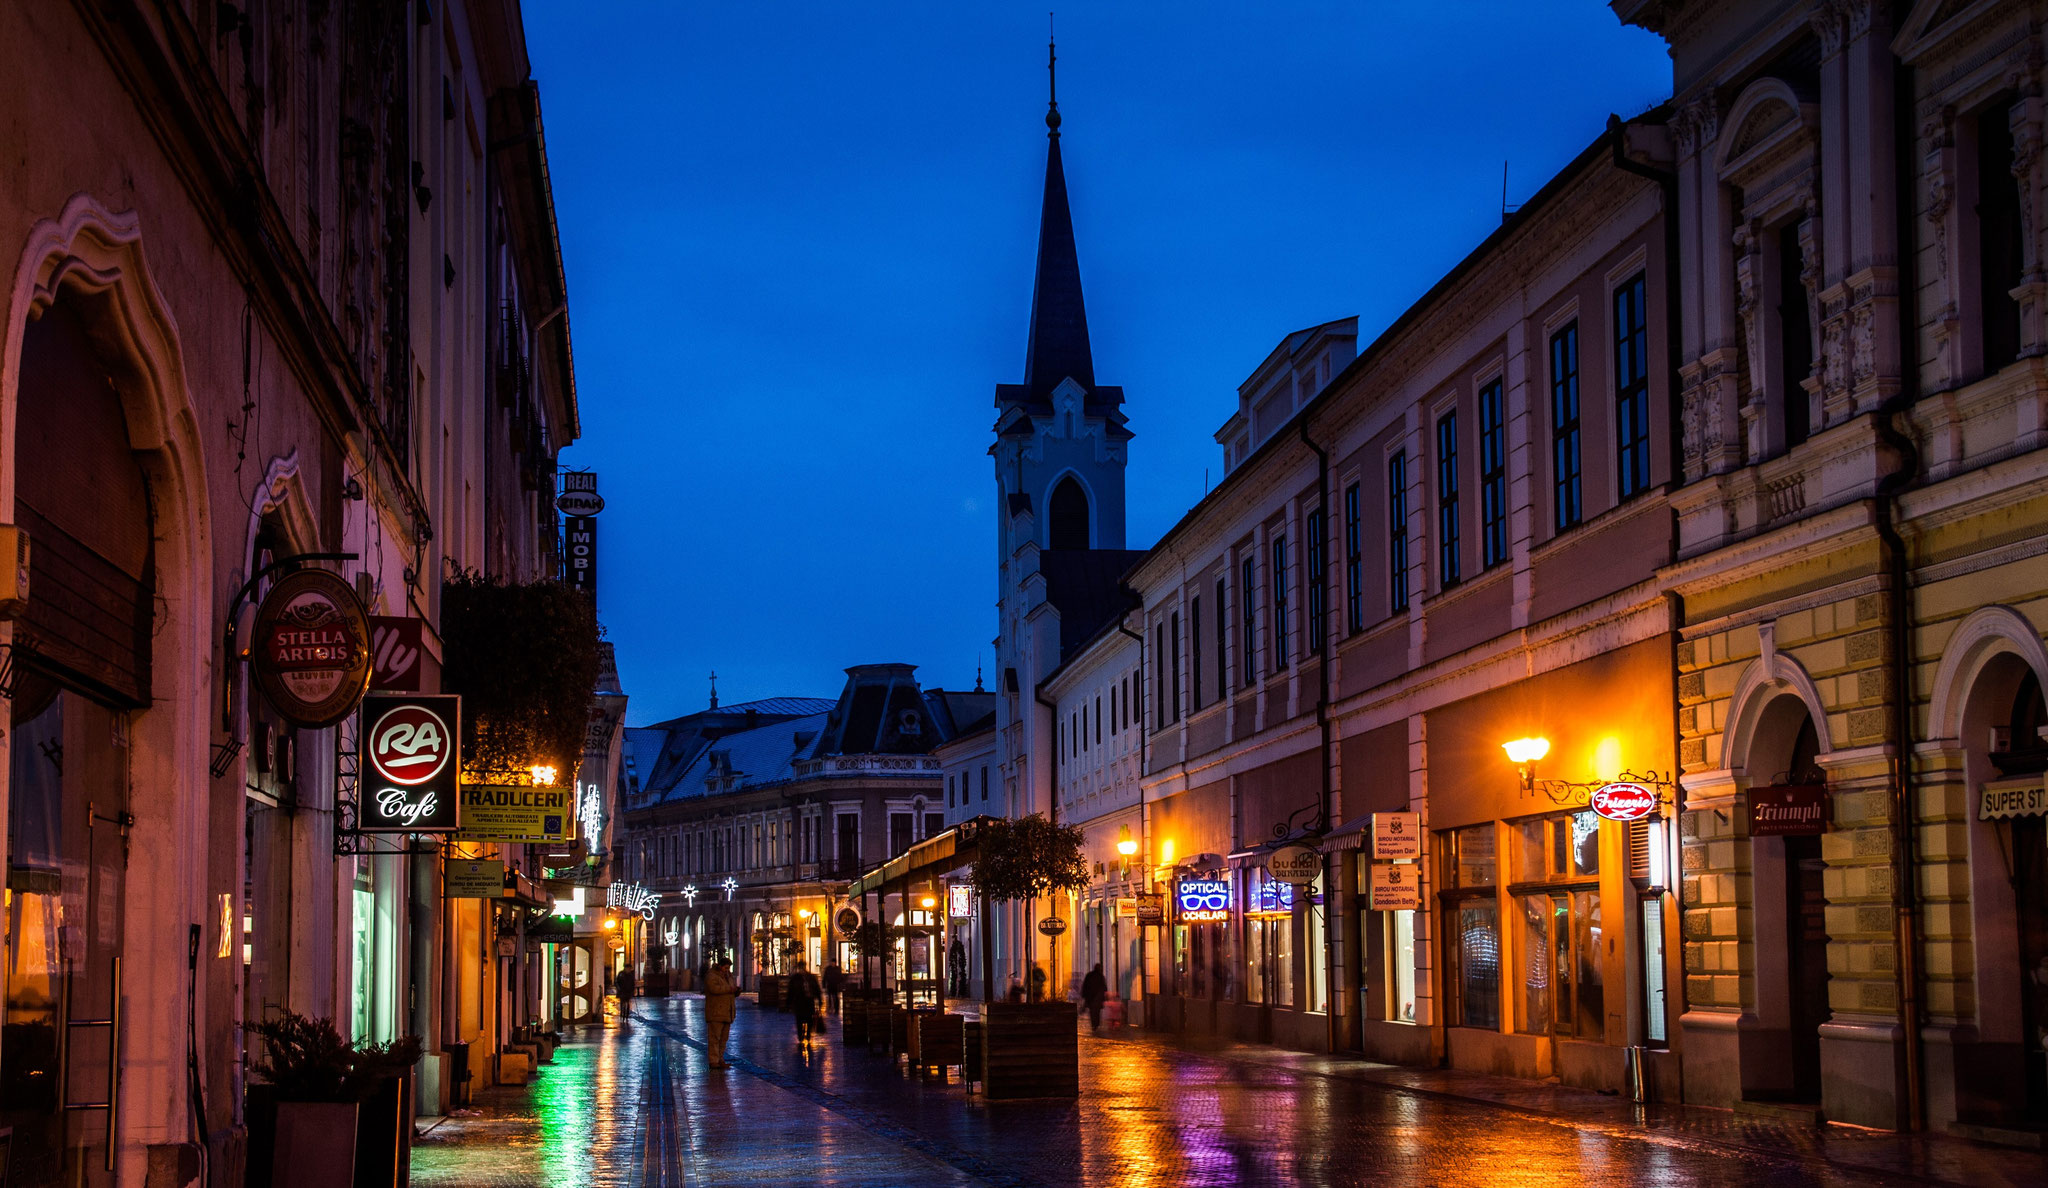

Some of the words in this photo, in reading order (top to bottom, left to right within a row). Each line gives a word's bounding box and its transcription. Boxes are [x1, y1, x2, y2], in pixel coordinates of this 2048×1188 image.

[567, 474, 595, 490] REAL
[572, 519, 590, 592] IMOBI
[277, 630, 347, 646] STELLA
[277, 646, 348, 662] ARTOIS
[291, 672, 334, 680] LEUVEN
[379, 722, 441, 755] RA
[376, 787, 438, 826] Café
[461, 791, 564, 807] TRADUCERI
[1595, 793, 1652, 808] Frizerie
[1985, 791, 2025, 812] SUPER
[2028, 789, 2045, 808] ST
[1755, 801, 1821, 823] Triumph
[1181, 883, 1227, 893] OPTICAL
[1182, 911, 1227, 920] OCHELARI
